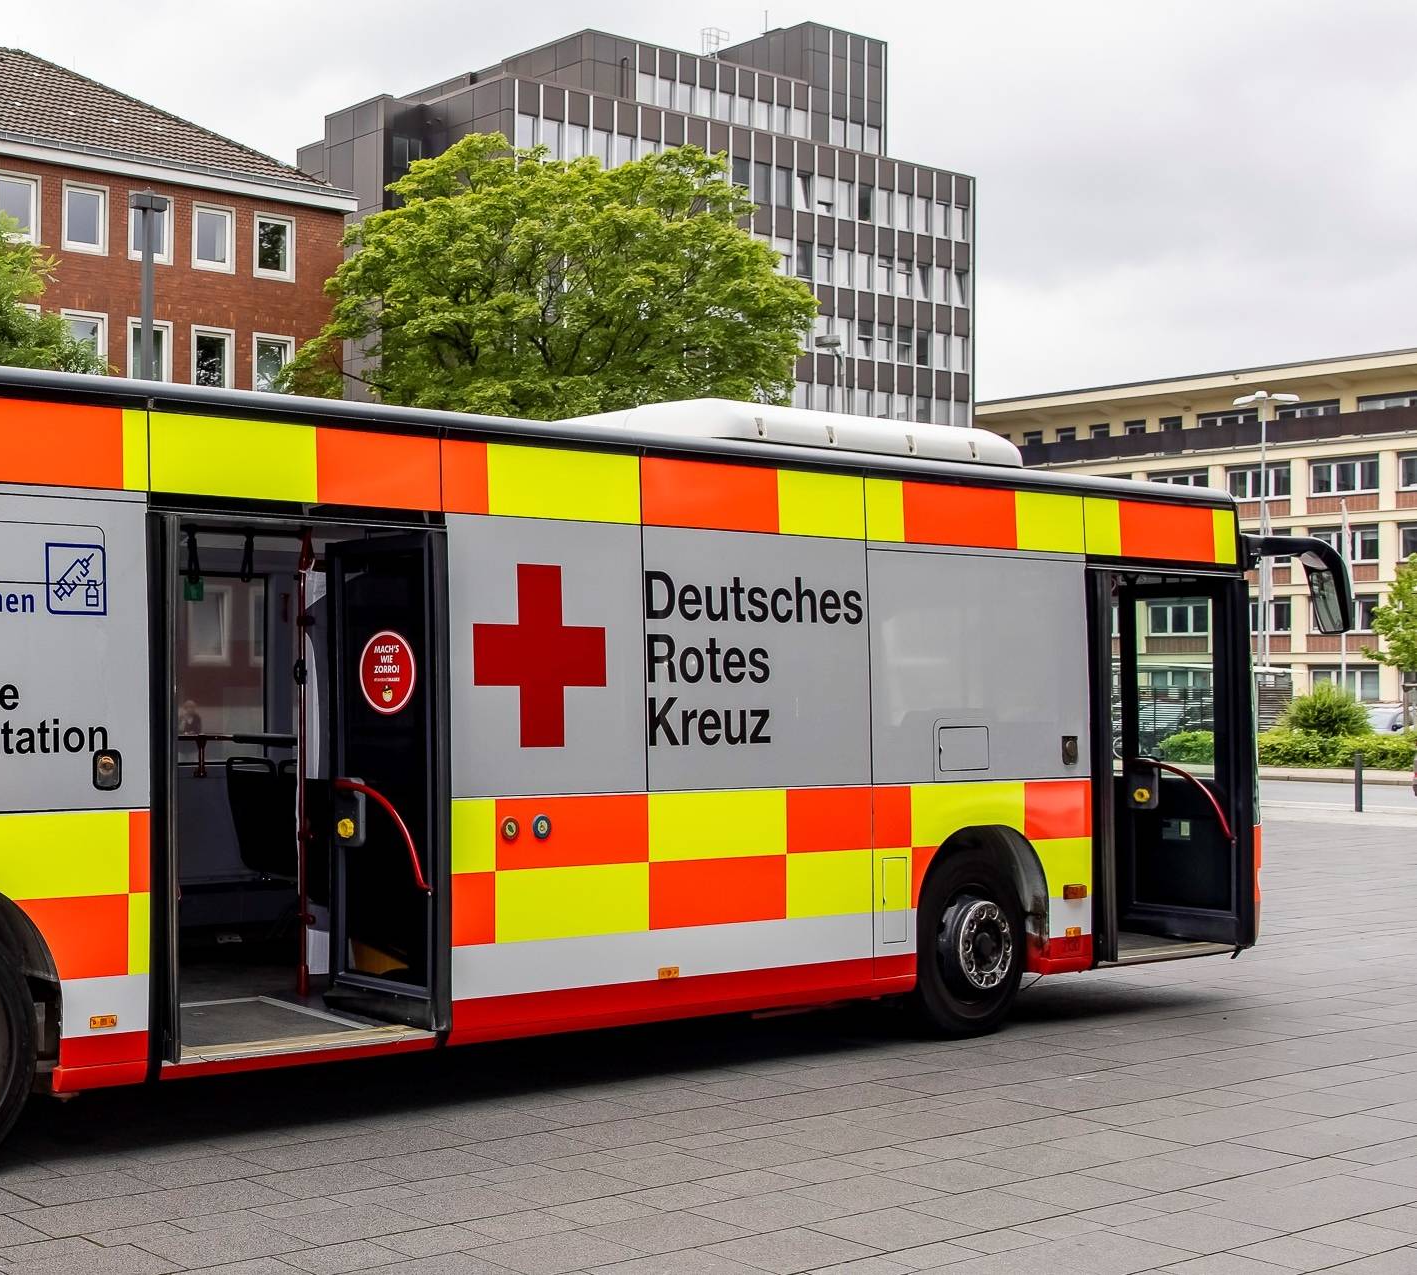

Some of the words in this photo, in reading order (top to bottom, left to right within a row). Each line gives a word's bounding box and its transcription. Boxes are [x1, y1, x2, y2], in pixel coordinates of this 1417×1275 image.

[645, 570, 864, 625] Deutsches
[374, 645, 399, 653] MACH'S
[380, 655, 393, 663] WIE
[647, 633, 770, 684] Rotes
[374, 665, 399, 673] ZORRO!
[648, 696, 772, 747] Kreuz
